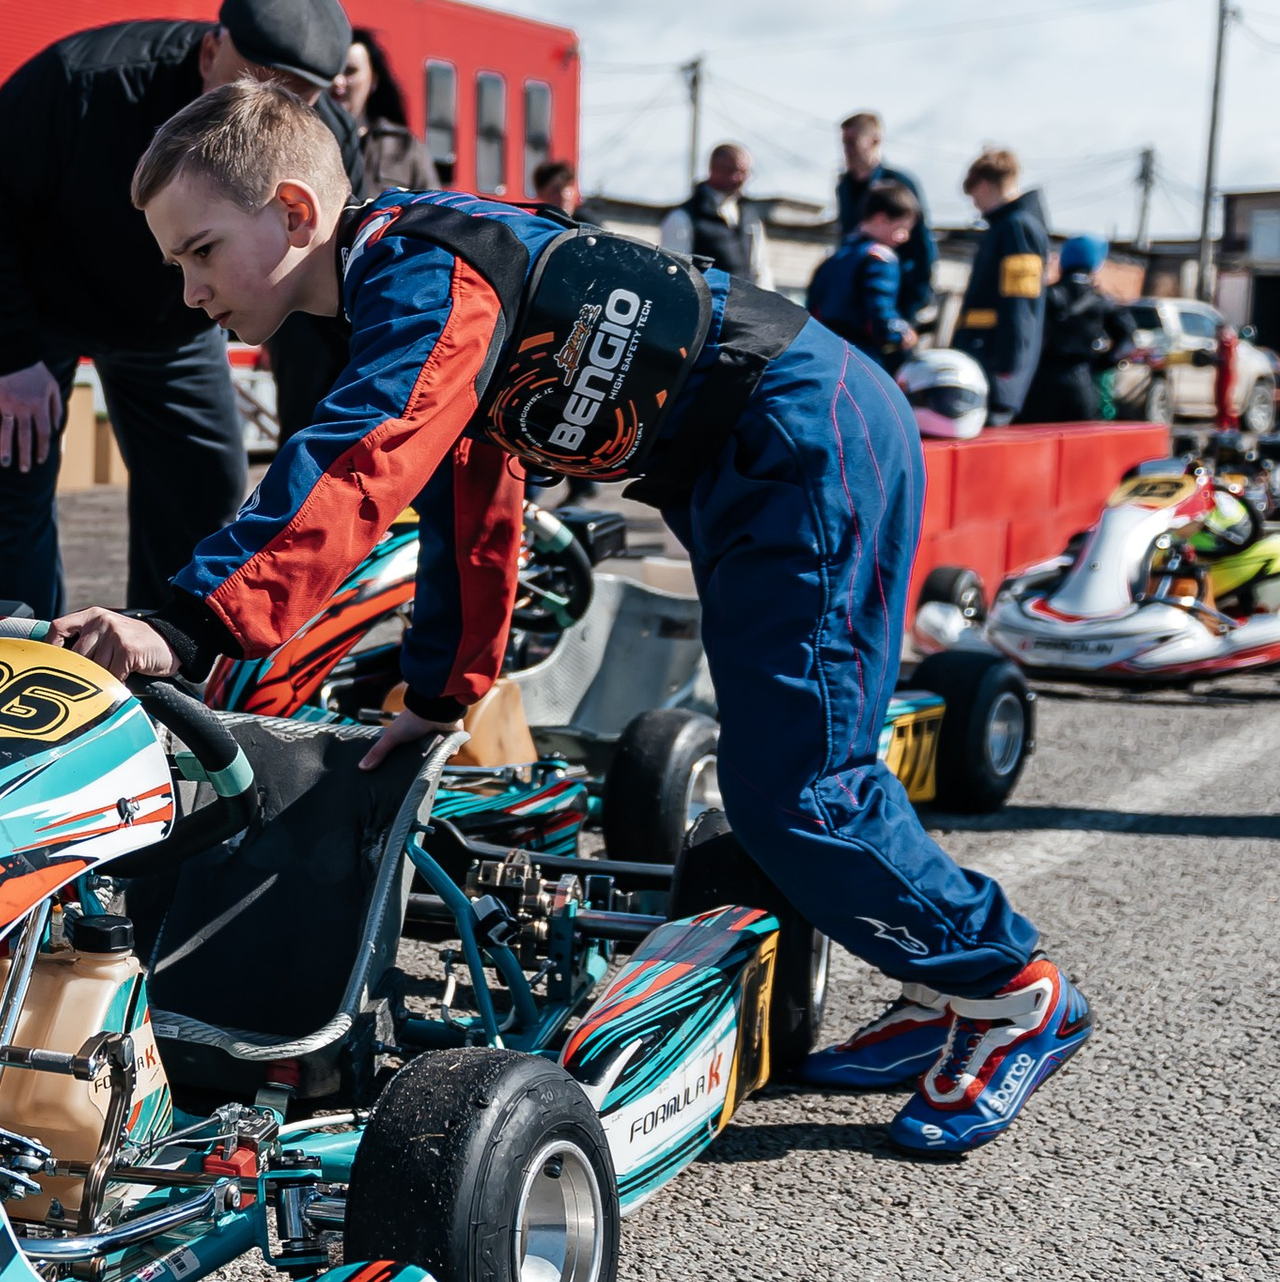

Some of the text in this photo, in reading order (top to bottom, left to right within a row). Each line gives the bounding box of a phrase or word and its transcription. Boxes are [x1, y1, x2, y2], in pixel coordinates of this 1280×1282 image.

[548, 288, 641, 451] BENGIO
[608, 299, 653, 400] HIGH SAFETY TECH
[629, 1052, 724, 1143] FORMULA K
[987, 1052, 1033, 1114] sparco
